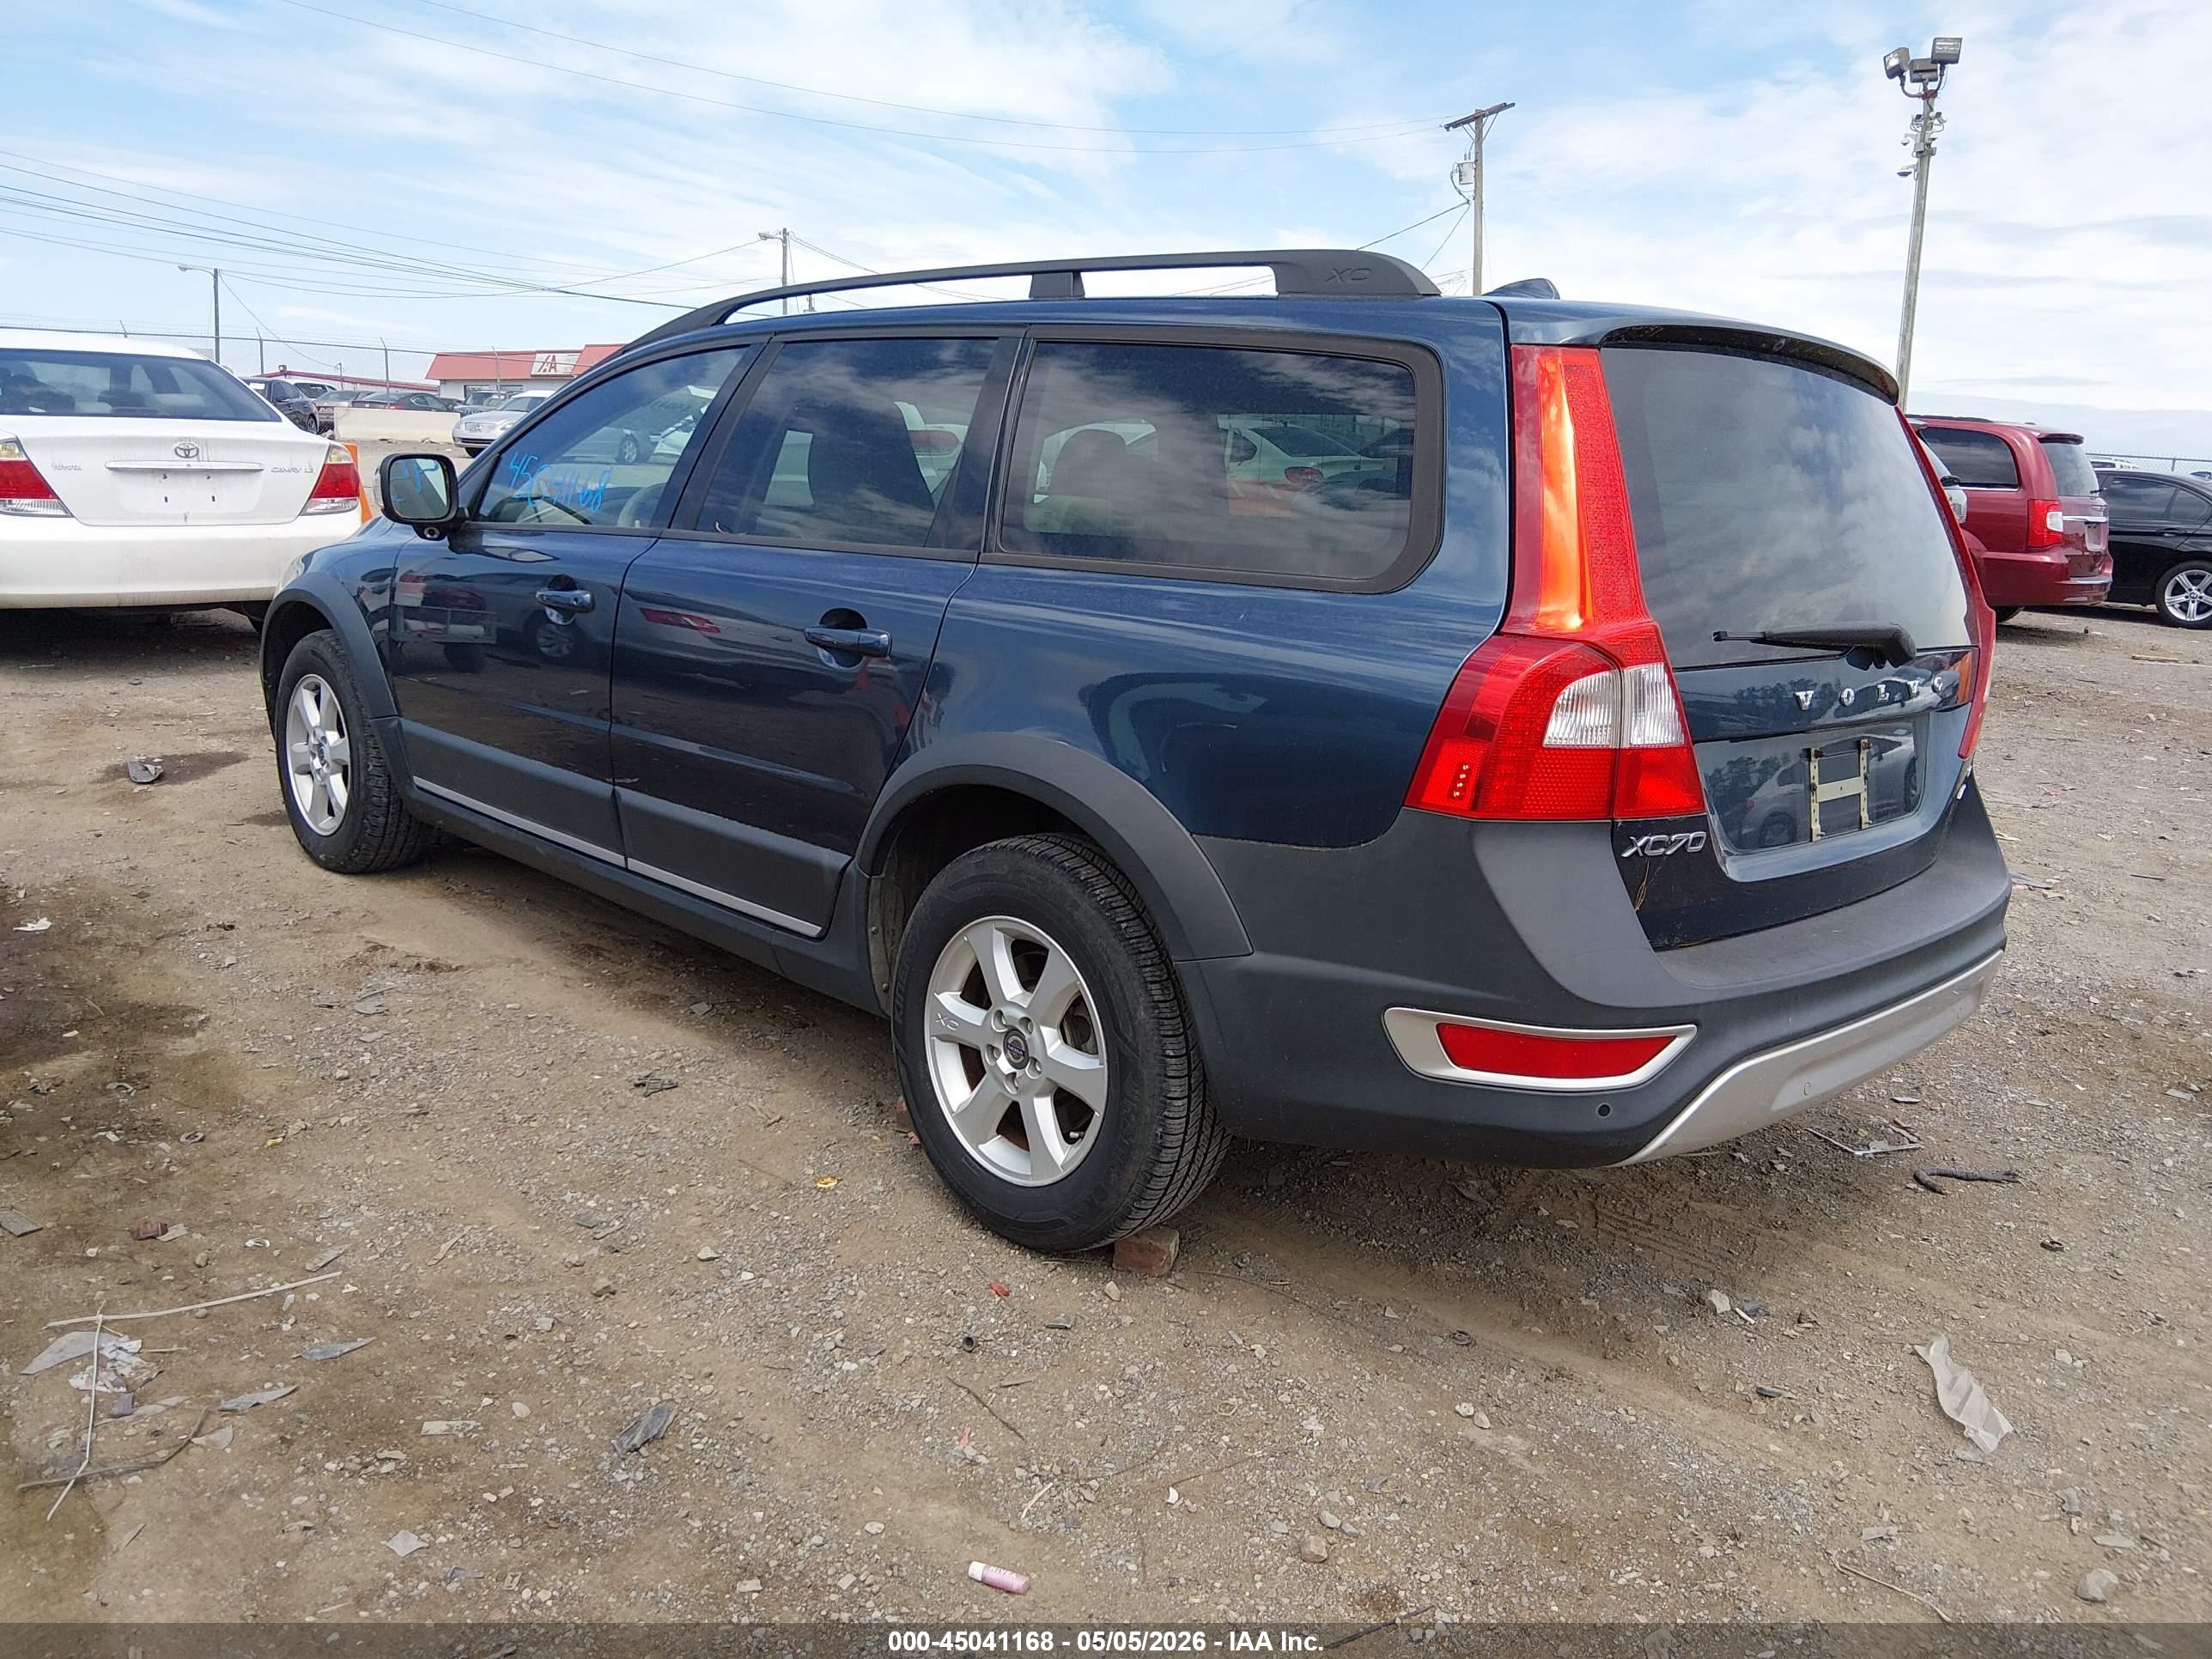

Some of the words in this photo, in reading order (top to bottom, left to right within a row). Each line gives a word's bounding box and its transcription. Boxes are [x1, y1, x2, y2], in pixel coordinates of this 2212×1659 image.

[1325, 267, 1373, 283] XC
[1794, 676, 1944, 711] VOLVO
[1620, 831, 1707, 857] XC70
